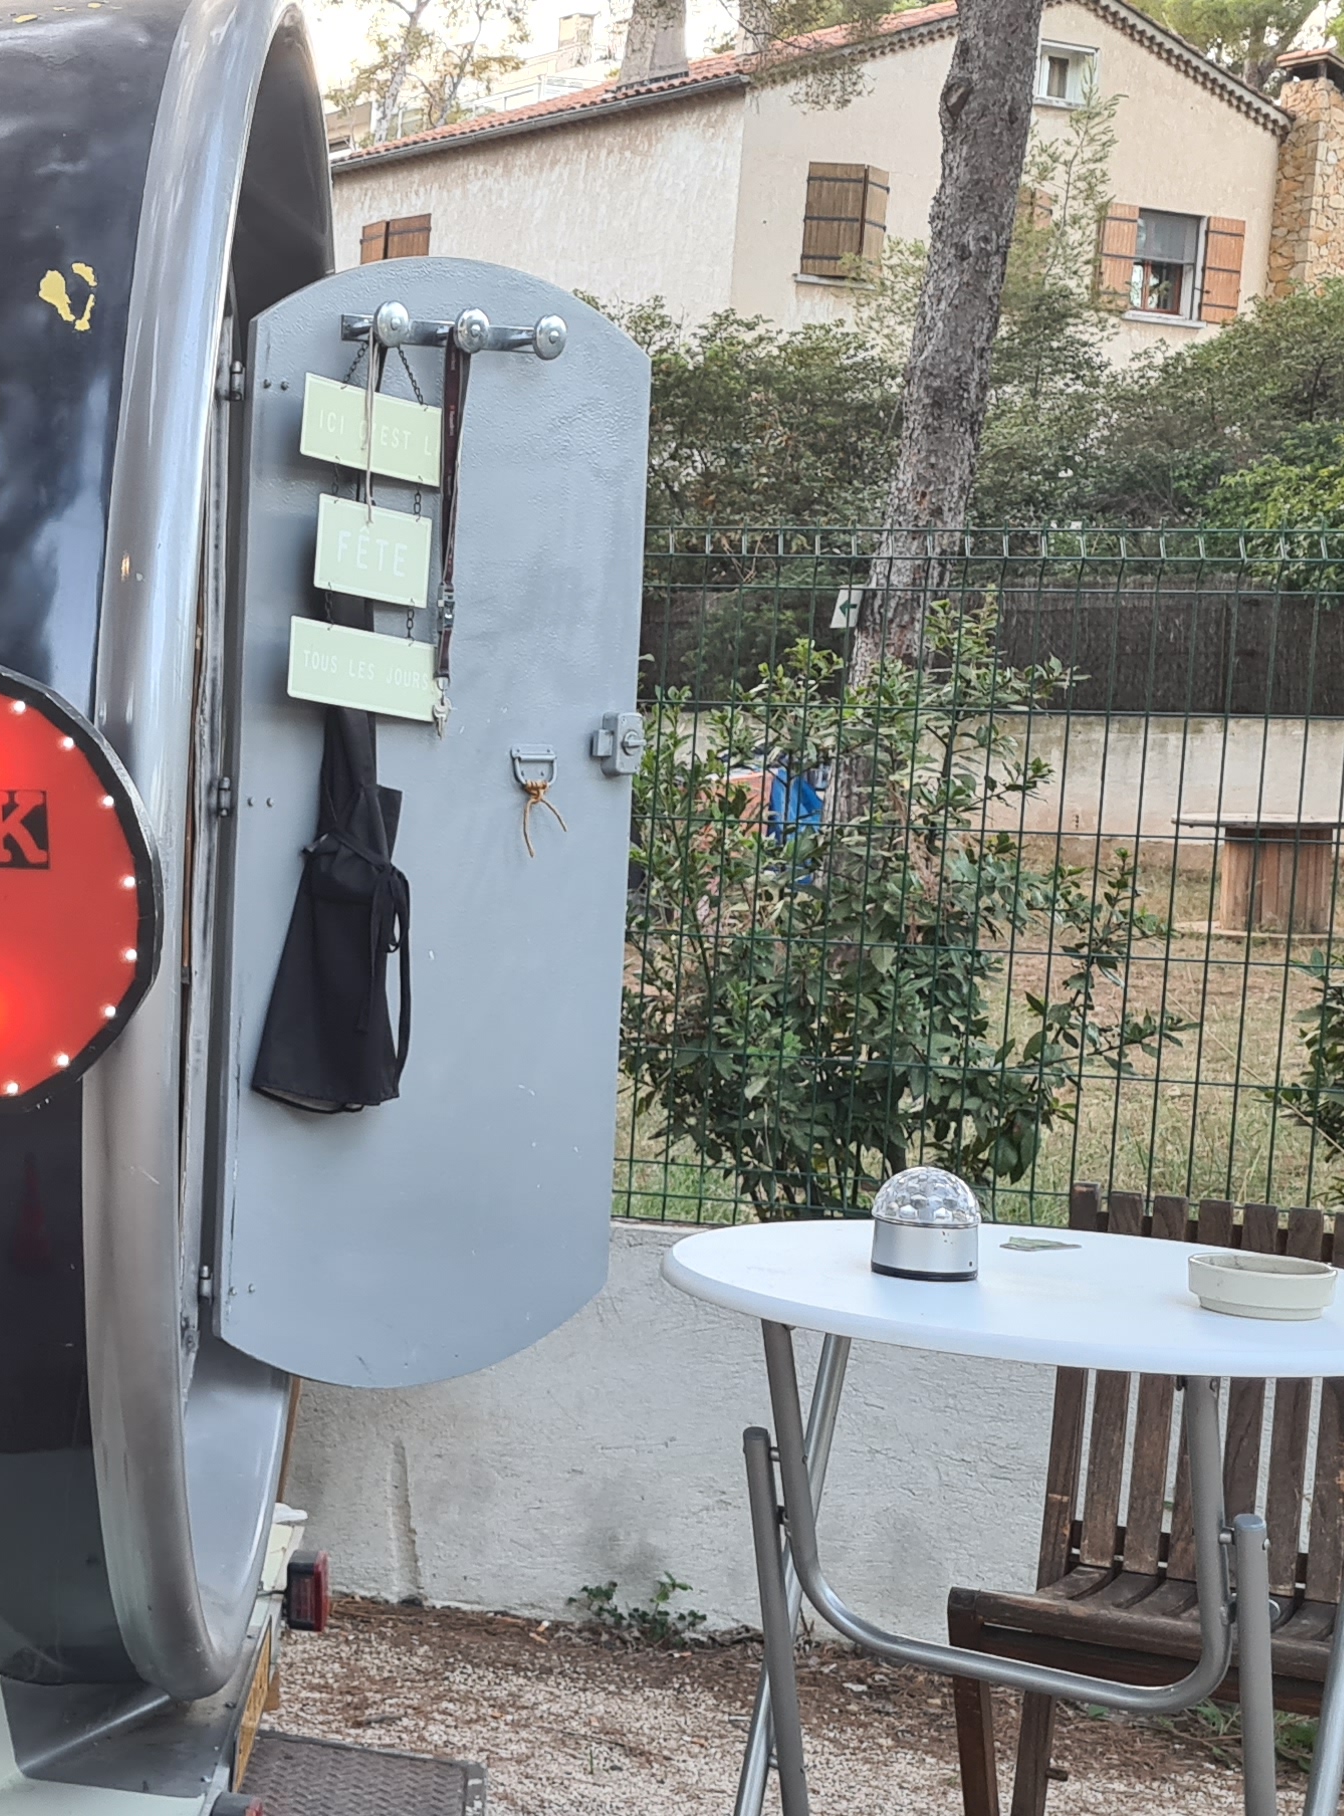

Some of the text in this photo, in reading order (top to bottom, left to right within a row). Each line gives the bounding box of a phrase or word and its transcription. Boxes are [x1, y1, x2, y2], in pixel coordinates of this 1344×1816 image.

[319, 409, 345, 435] ICI
[337, 524, 409, 578] FÊTE
[303, 649, 429, 691] TOUS LES JOURS
